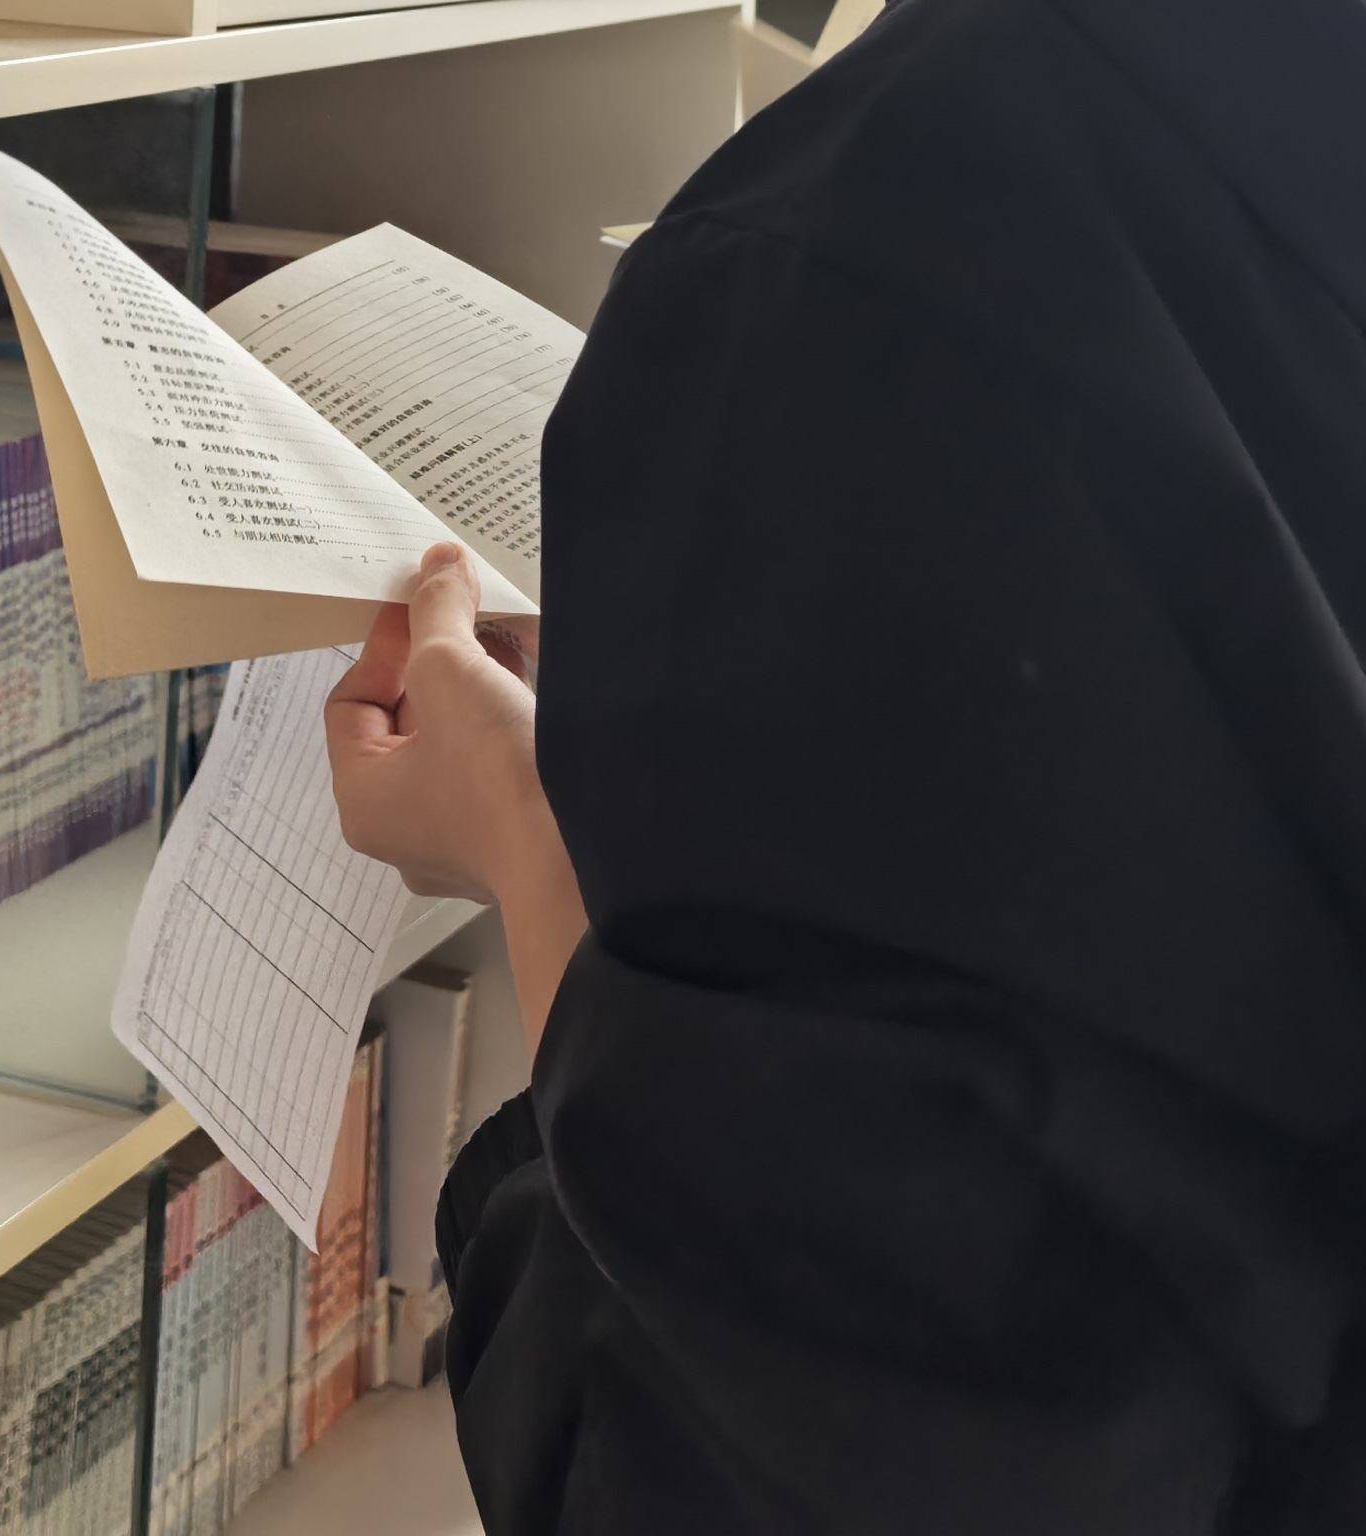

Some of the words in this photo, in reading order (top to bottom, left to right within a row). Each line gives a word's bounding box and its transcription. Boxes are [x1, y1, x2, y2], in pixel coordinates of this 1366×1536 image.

[287, 370, 312, 388] 测试
[309, 374, 356, 406] 力测试(一)
[181, 479, 200, 489] 6.2
[188, 495, 207, 505] 6.3
[195, 512, 214, 521] 6.4
[202, 529, 221, 539] 6.5
